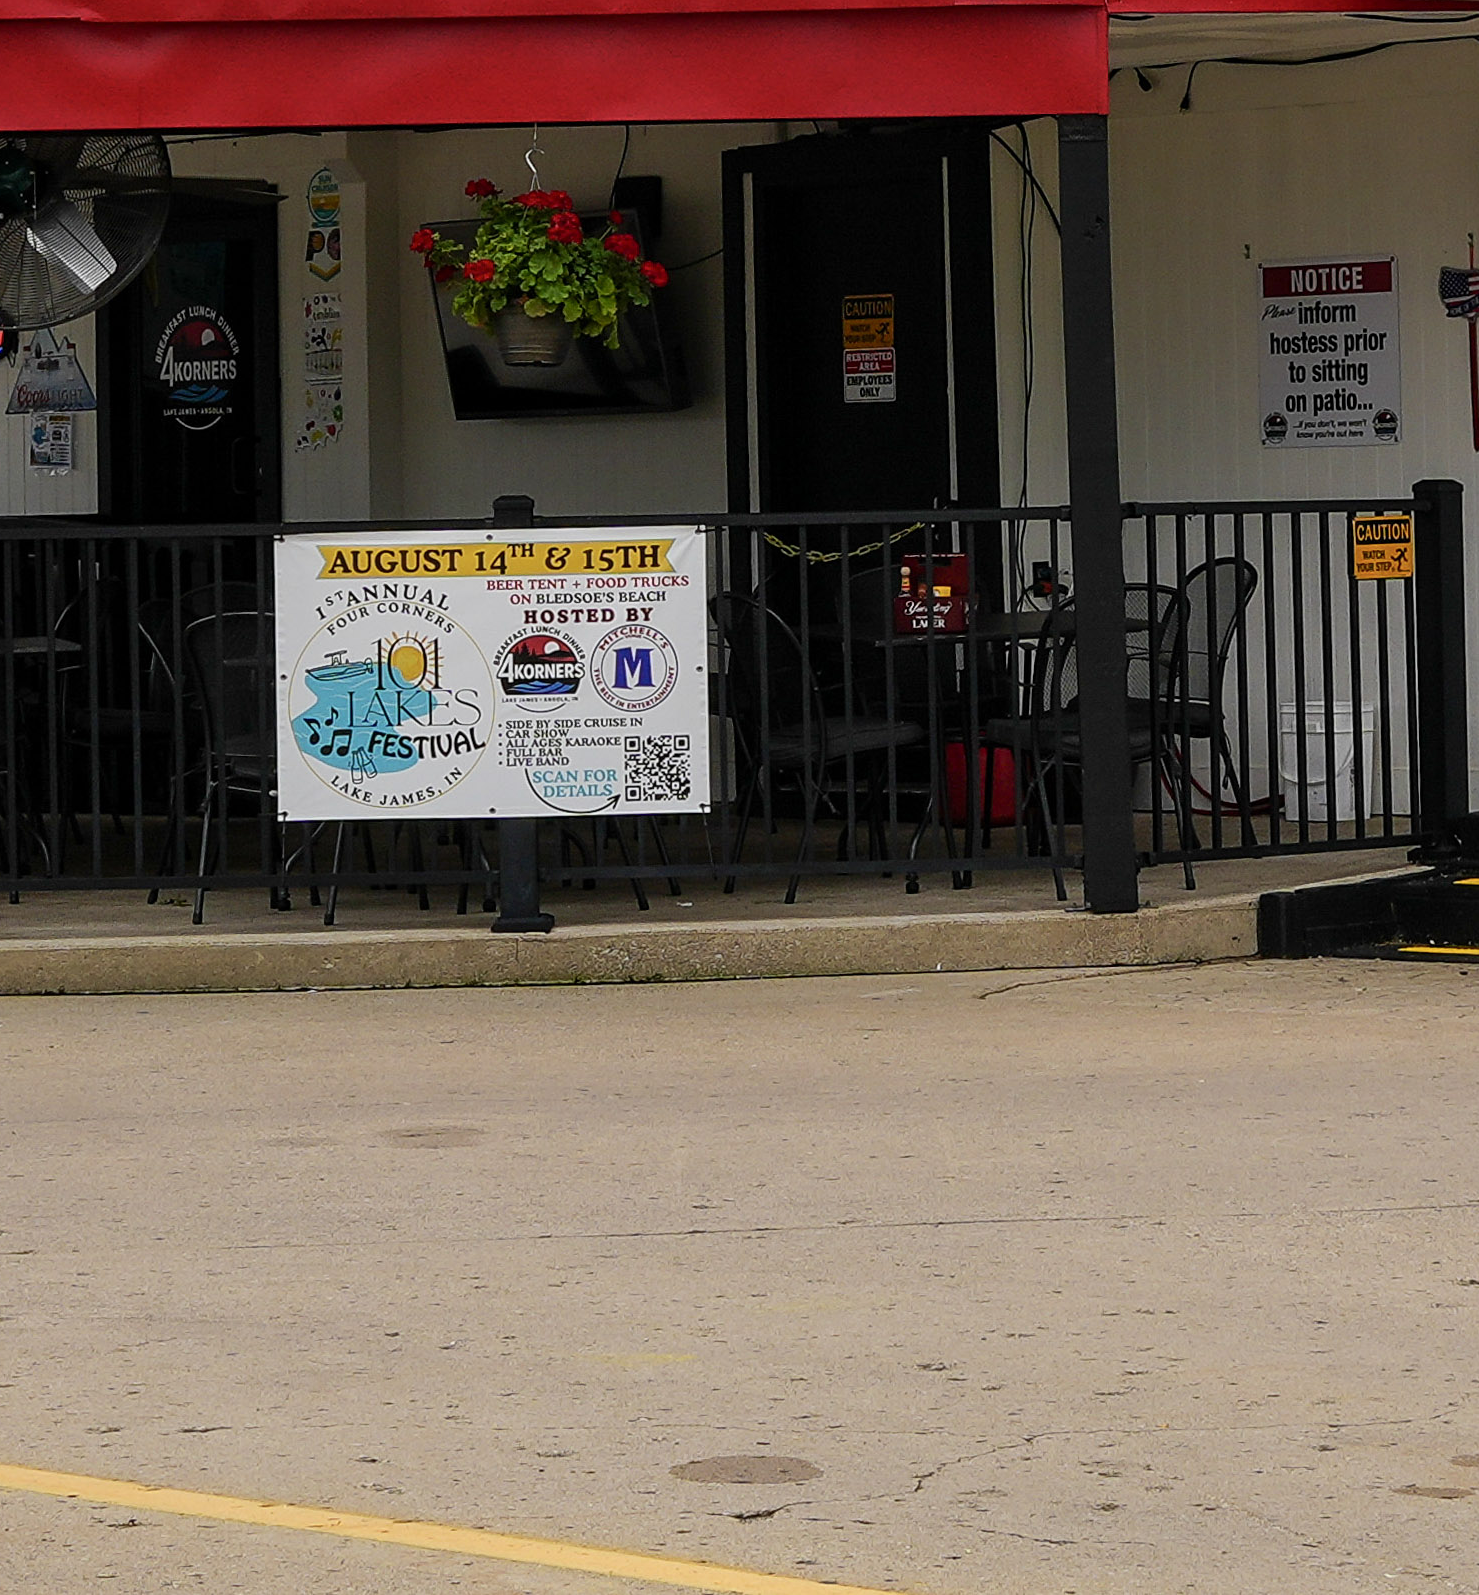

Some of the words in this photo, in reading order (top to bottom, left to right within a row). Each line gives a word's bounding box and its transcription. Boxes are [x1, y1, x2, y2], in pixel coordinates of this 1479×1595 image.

[1291, 266, 1363, 293] NOTICE
[845, 300, 892, 316] CAUTION
[1261, 304, 1296, 320] Please
[1298, 301, 1356, 324] inform
[155, 310, 186, 363] BREAKFAST
[188, 306, 216, 320] LUNCH
[217, 316, 240, 355] DINNER
[1270, 332, 1337, 354] hostess
[1344, 328, 1387, 356] prior
[160, 346, 237, 387] 4KORNERS
[846, 352, 892, 362] RESTRICTED
[859, 362, 880, 371] AREA
[847, 375, 892, 386] EMPLOYEES
[1288, 361, 1306, 383] to
[1312, 358, 1368, 386] sitting
[17, 384, 50, 406] Coors
[860, 387, 880, 397] ONLY
[1285, 393, 1307, 413] on
[1313, 388, 1373, 416] patio...
[1357, 523, 1409, 541] CAUTION
[328, 549, 463, 574] AUGUST
[475, 543, 534, 575] 14TH
[544, 547, 571, 570] &
[583, 545, 660, 571] 15TH
[1362, 550, 1385, 559] WATCH
[1356, 563, 1374, 572] YOUR
[486, 579, 524, 590] BEER
[528, 578, 567, 590] TENT
[572, 579, 581, 589] +
[586, 577, 627, 589] FOOD
[631, 575, 689, 588] TRUCKS
[346, 583, 450, 611] ANNUAL
[510, 594, 531, 605] ON
[535, 592, 615, 604] BLEDSOE'S
[619, 590, 666, 602] BEACH
[327, 607, 370, 635] FOUR
[377, 602, 455, 634] CORNERS
[524, 608, 615, 624] HOSTED
[625, 607, 653, 622] BY
[493, 628, 527, 666] BREAKFAST
[531, 626, 561, 637] LUNCH
[562, 633, 586, 659] DINNER
[599, 626, 669, 651] MITCHELL'S
[371, 636, 443, 690] 101
[497, 653, 585, 683] 4KORNERS
[611, 647, 656, 690] M
[594, 667, 603, 685] THE
[600, 687, 616, 702] BEST
[627, 666, 674, 709] ENTERTAINMENT
[347, 689, 481, 727] LAKES
[506, 720, 534, 729] SIDE
[536, 720, 551, 729] BY
[554, 719, 581, 728] SIDE
[584, 718, 627, 727] CRUISE
[630, 718, 643, 726] IN
[506, 730, 530, 739] CAR
[533, 729, 570, 738] SHOW
[368, 727, 486, 759] FESTIVAL
[506, 739, 527, 748] ALL
[531, 738, 562, 747] AGES
[565, 737, 621, 747] KARAOKE
[506, 749, 535, 757] FULL
[538, 748, 563, 757] BAR
[506, 758, 533, 767] LIVE
[536, 757, 570, 766] BAND
[330, 775, 372, 803] LAKE
[379, 786, 443, 806] JAMES,
[444, 766, 463, 786] IN
[532, 770, 580, 783] SCAN
[584, 769, 618, 782] FOR
[543, 784, 613, 798] DETAILS
